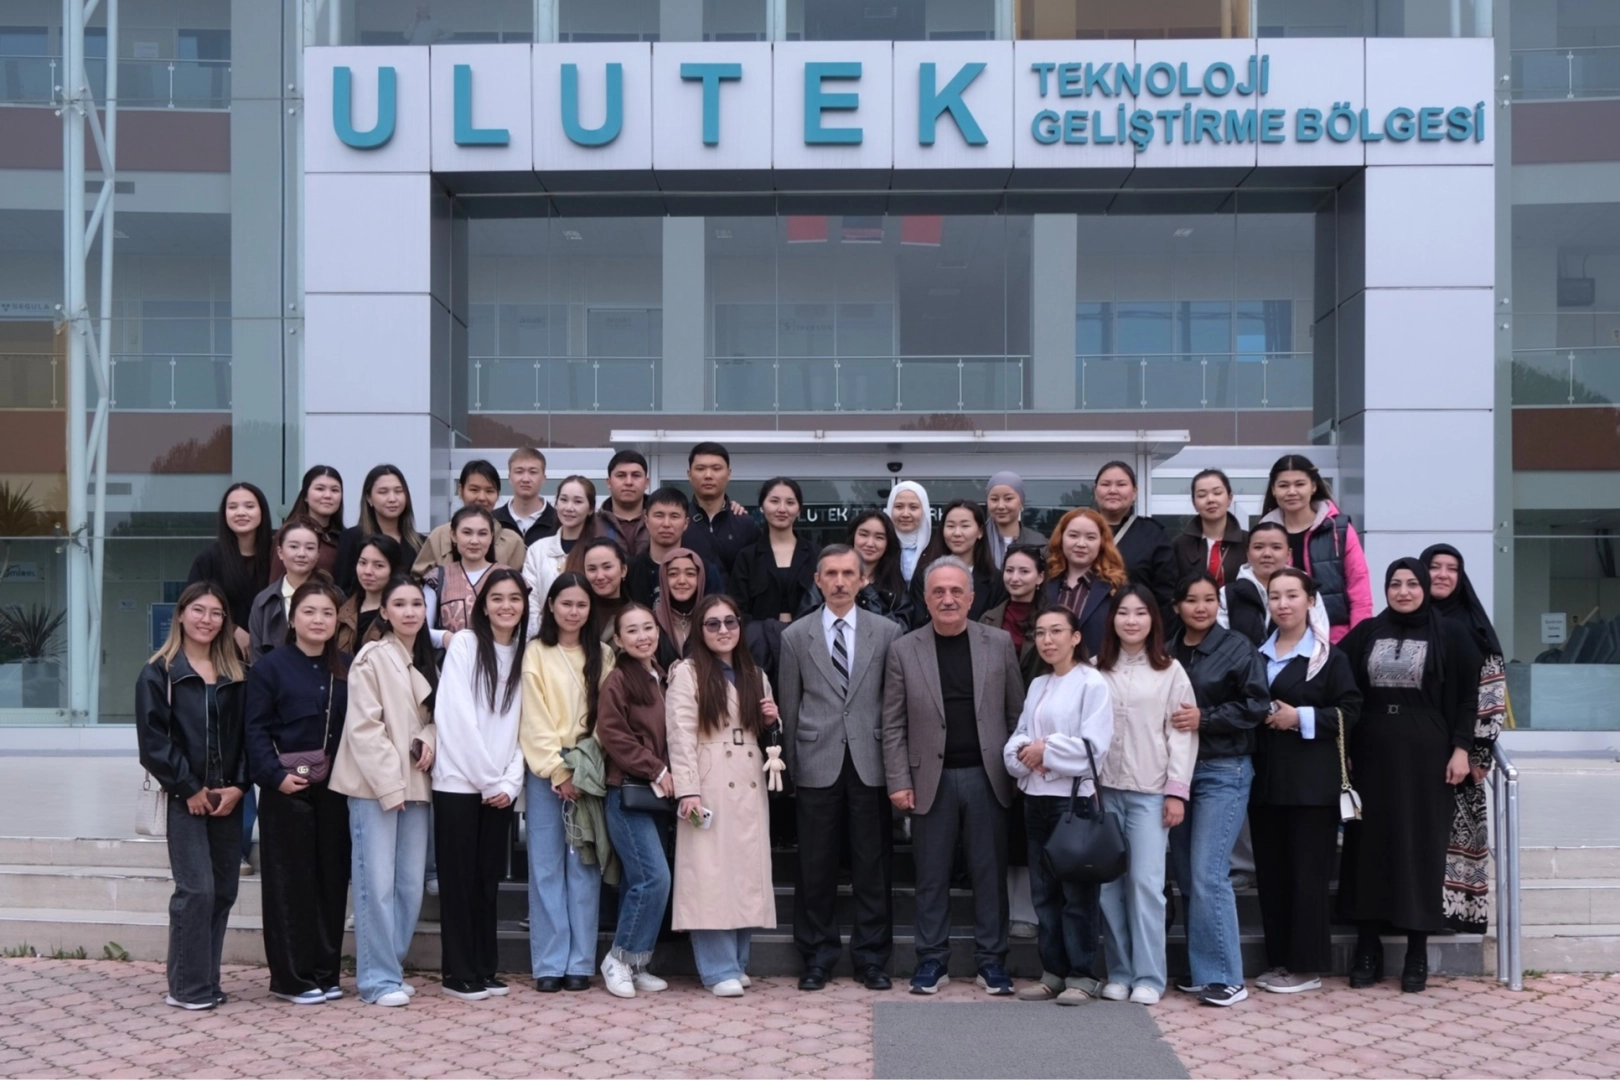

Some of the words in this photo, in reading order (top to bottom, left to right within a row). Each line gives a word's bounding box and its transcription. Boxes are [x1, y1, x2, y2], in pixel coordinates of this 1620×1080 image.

[1031, 55, 1269, 97] TEKNOLOJİ
[333, 62, 988, 149] ULUTEK
[1031, 102, 1286, 153] GELİŞTİRME
[1296, 101, 1485, 143] BÖLGESİ
[797, 507, 848, 522] LUTEK
